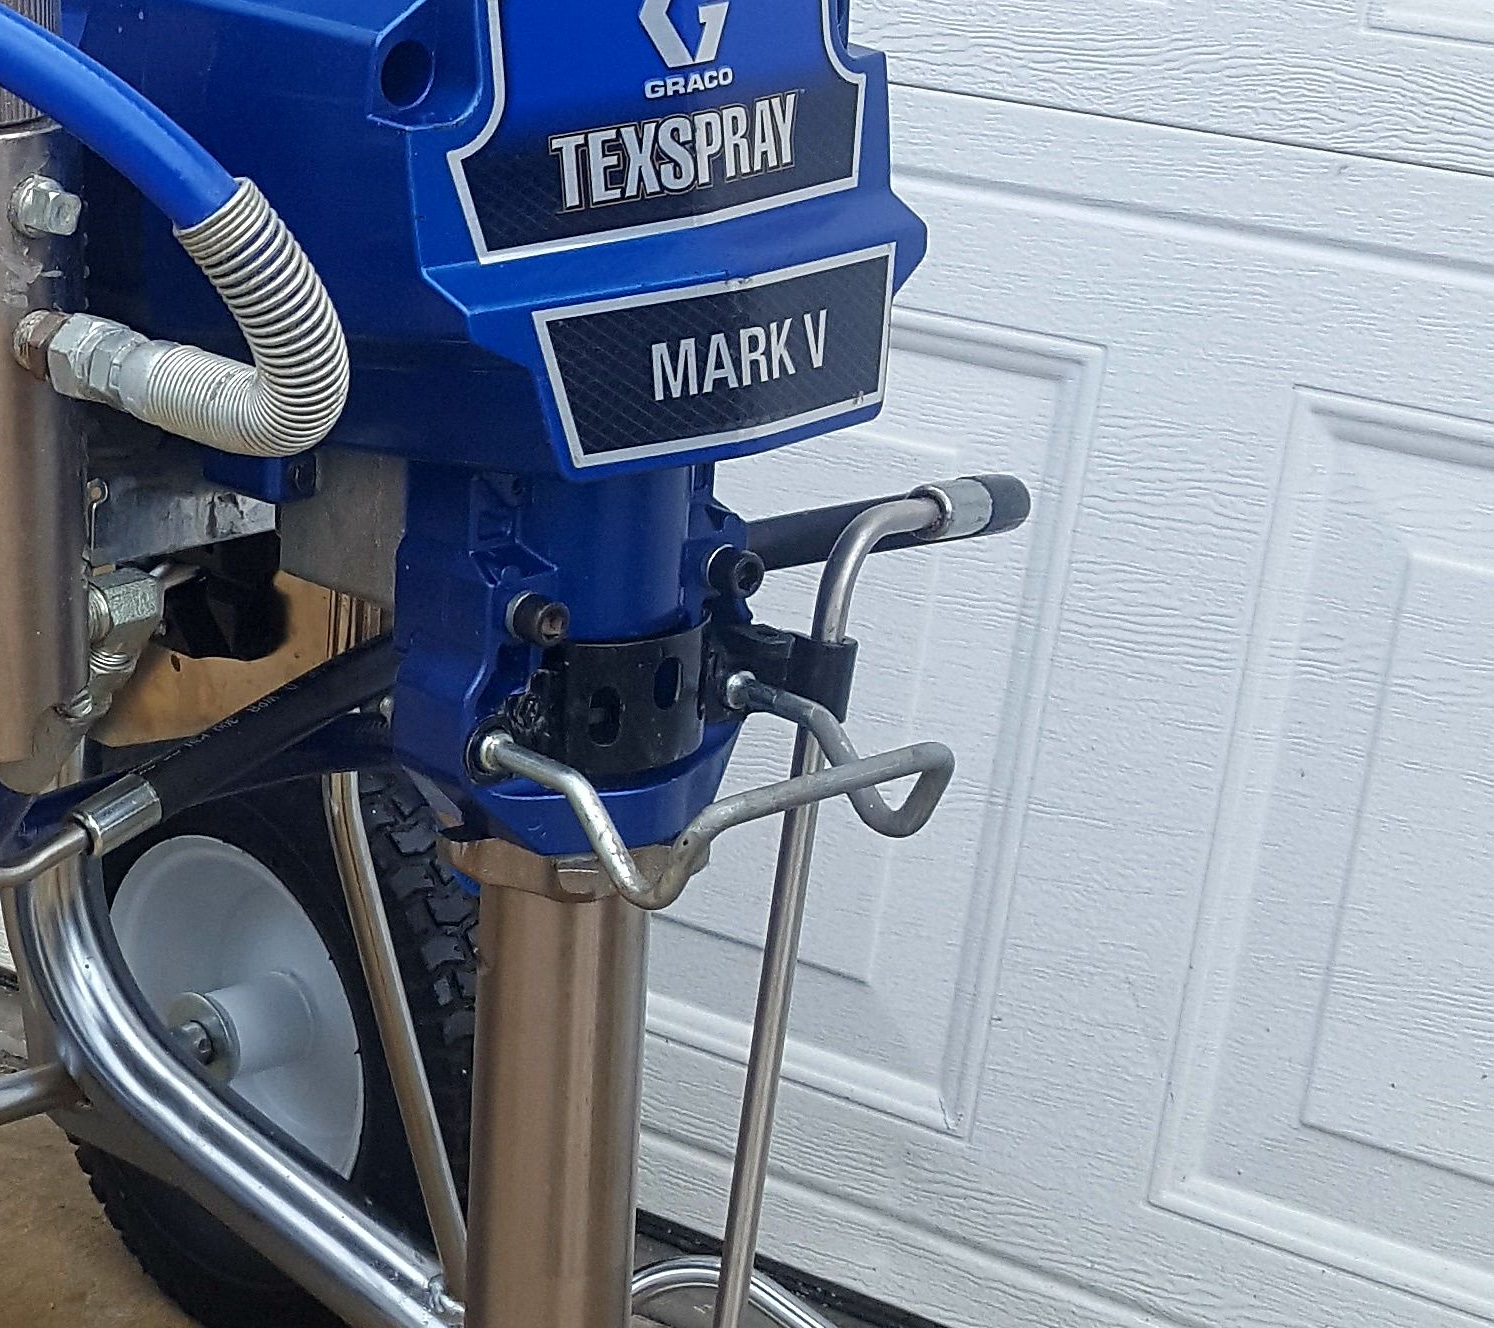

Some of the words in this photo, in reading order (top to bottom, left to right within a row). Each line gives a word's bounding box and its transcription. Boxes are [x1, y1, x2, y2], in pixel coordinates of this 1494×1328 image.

[644, 67, 734, 99] GRACO
[550, 91, 798, 210] TEXSPRAY
[651, 318, 796, 401] MARK
[803, 309, 828, 369] V
